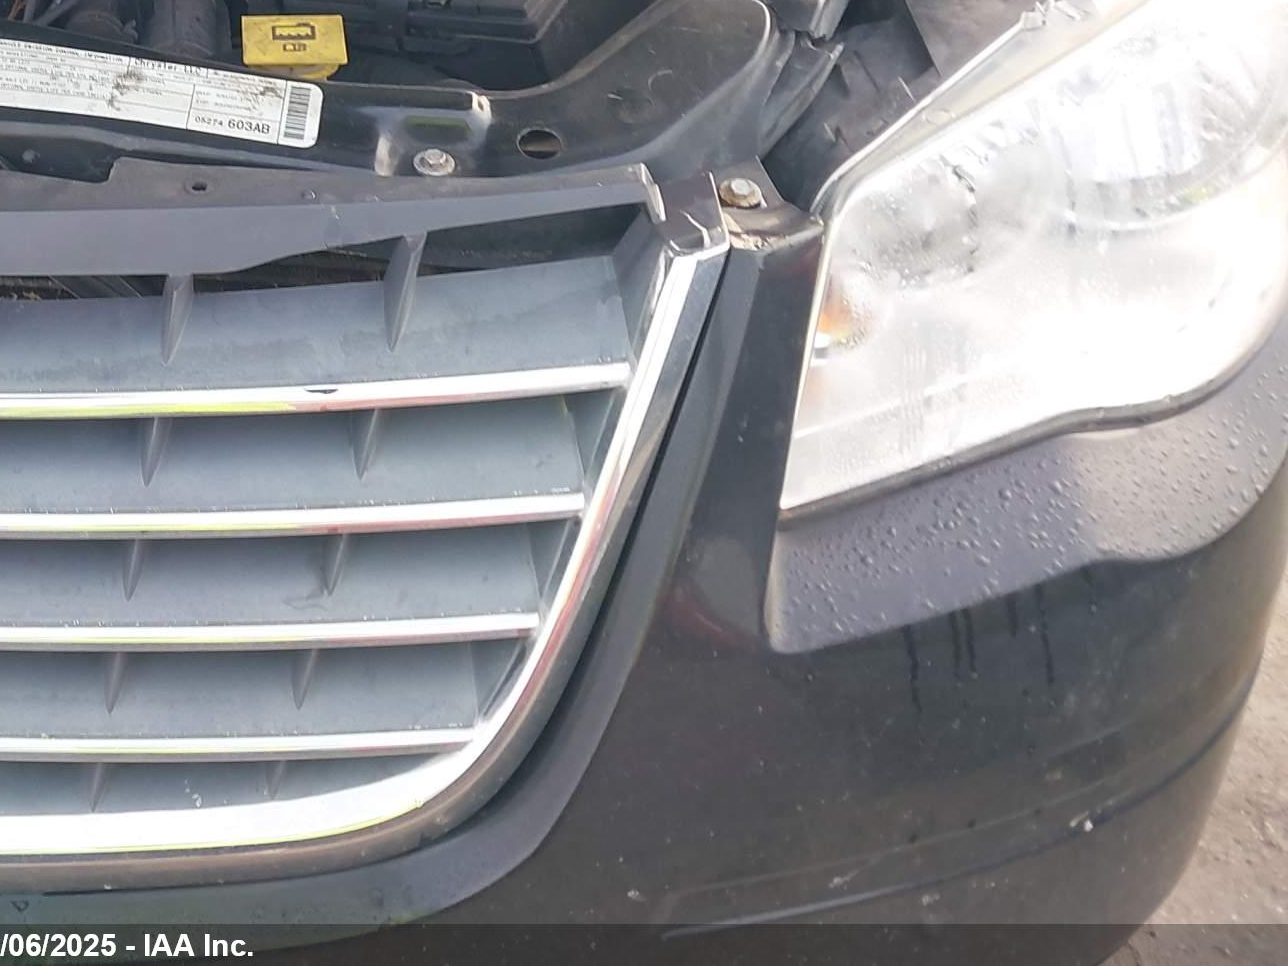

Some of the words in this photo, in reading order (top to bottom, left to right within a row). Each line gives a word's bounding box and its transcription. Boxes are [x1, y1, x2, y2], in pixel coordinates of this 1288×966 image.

[134, 58, 177, 73] Chrysler
[184, 64, 202, 76] LLC
[227, 118, 271, 135] 603AB
